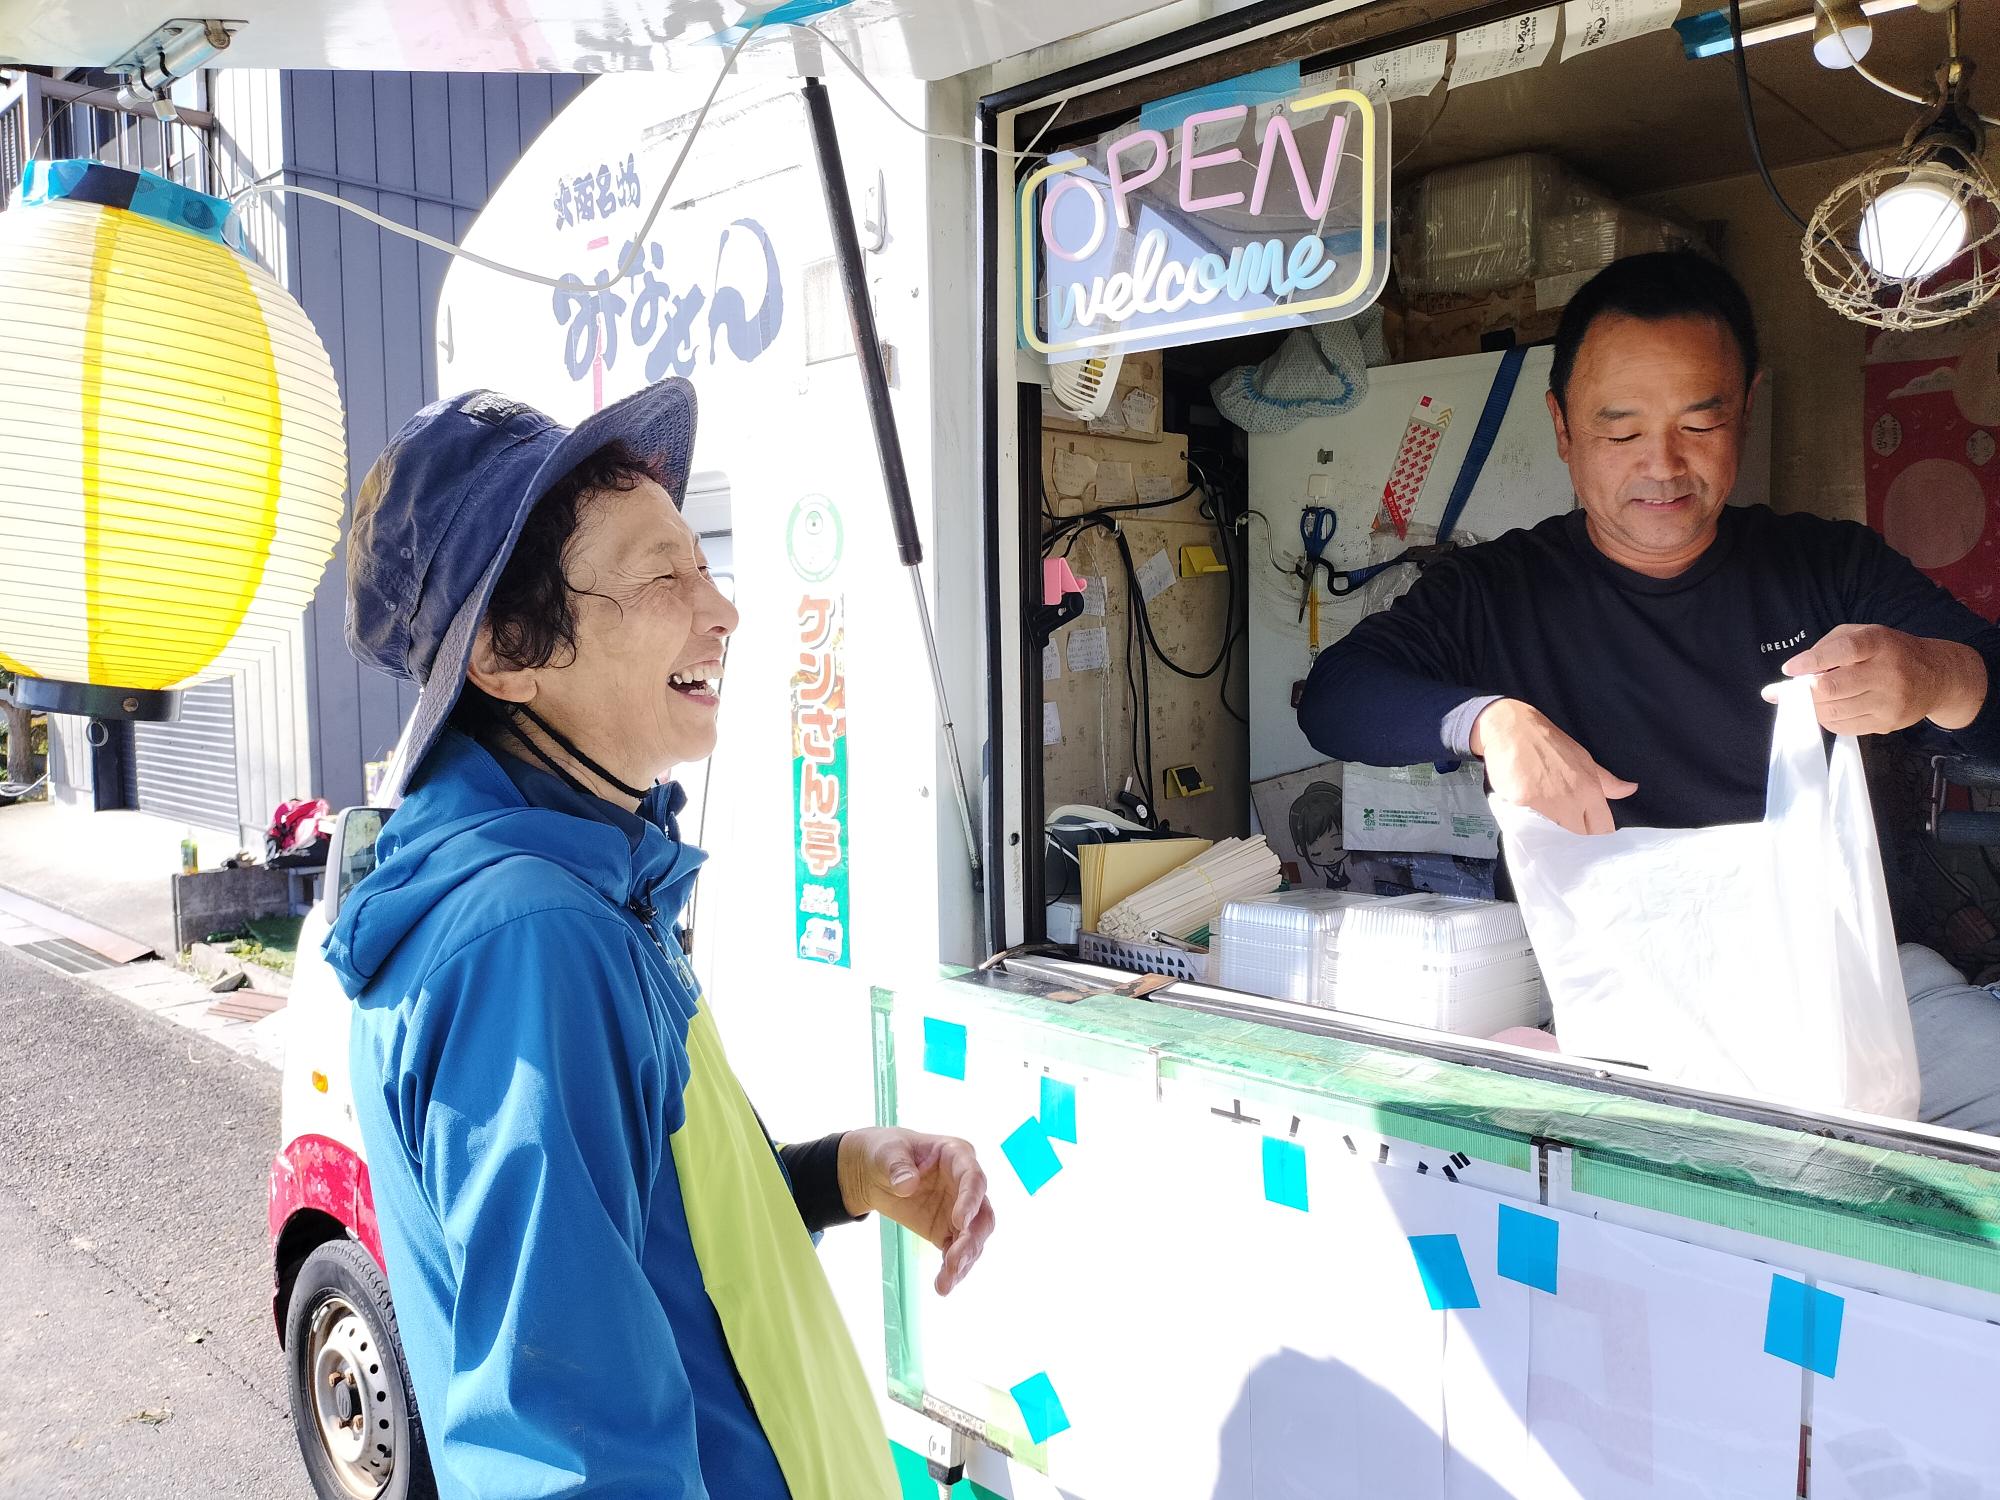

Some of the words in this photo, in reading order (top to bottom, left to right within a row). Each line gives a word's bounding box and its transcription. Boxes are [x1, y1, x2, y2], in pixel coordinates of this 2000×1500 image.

[1041, 105, 1346, 262] OPEN
[1050, 229, 1337, 330] welcome
[797, 594, 841, 872] ケンさん亭
